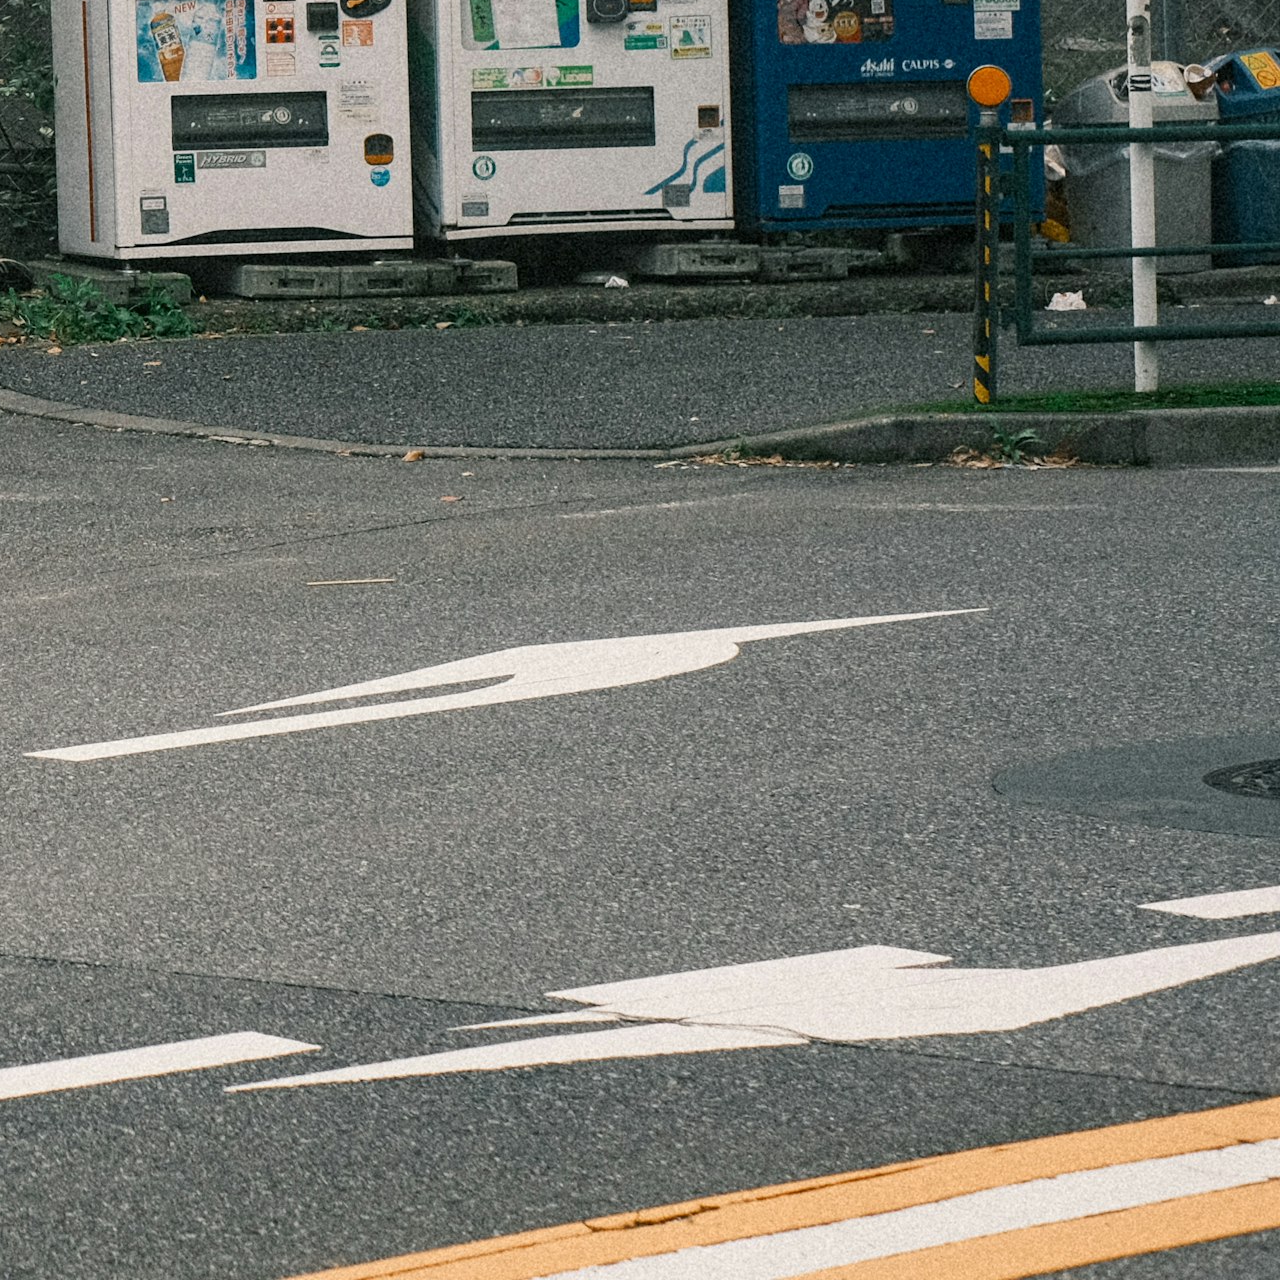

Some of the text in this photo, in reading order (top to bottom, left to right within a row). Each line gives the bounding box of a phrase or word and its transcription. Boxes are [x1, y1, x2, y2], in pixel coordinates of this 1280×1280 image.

[174, 0, 197, 14] NEW
[860, 57, 895, 73] Asahi
[902, 59, 939, 72] CALPIS
[200, 155, 247, 168] HYBRID
